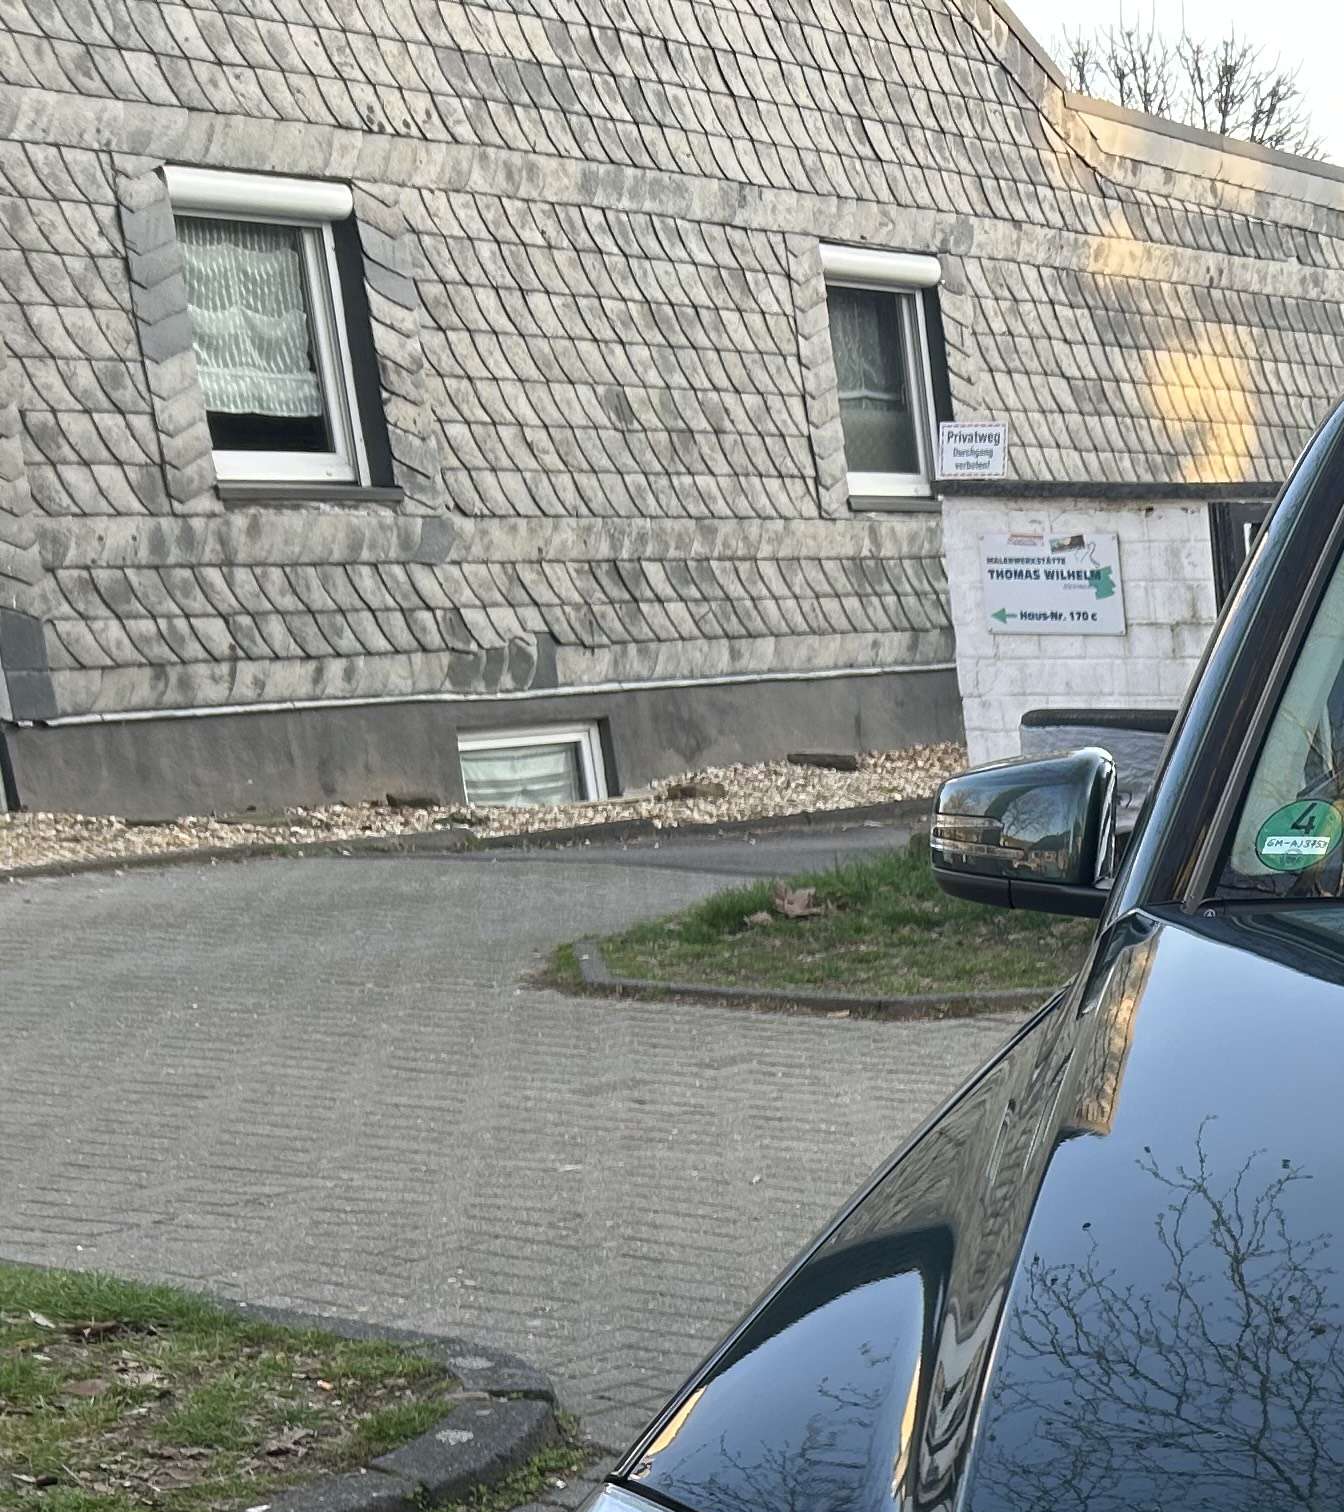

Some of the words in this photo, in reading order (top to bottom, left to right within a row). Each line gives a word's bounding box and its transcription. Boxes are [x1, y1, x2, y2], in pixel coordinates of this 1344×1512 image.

[947, 430, 1001, 447] Privatweg
[988, 569, 1041, 581] THOMAS
[1043, 569, 1101, 581] WILHELM
[1069, 611, 1089, 621] 170
[1290, 802, 1318, 835] 4
